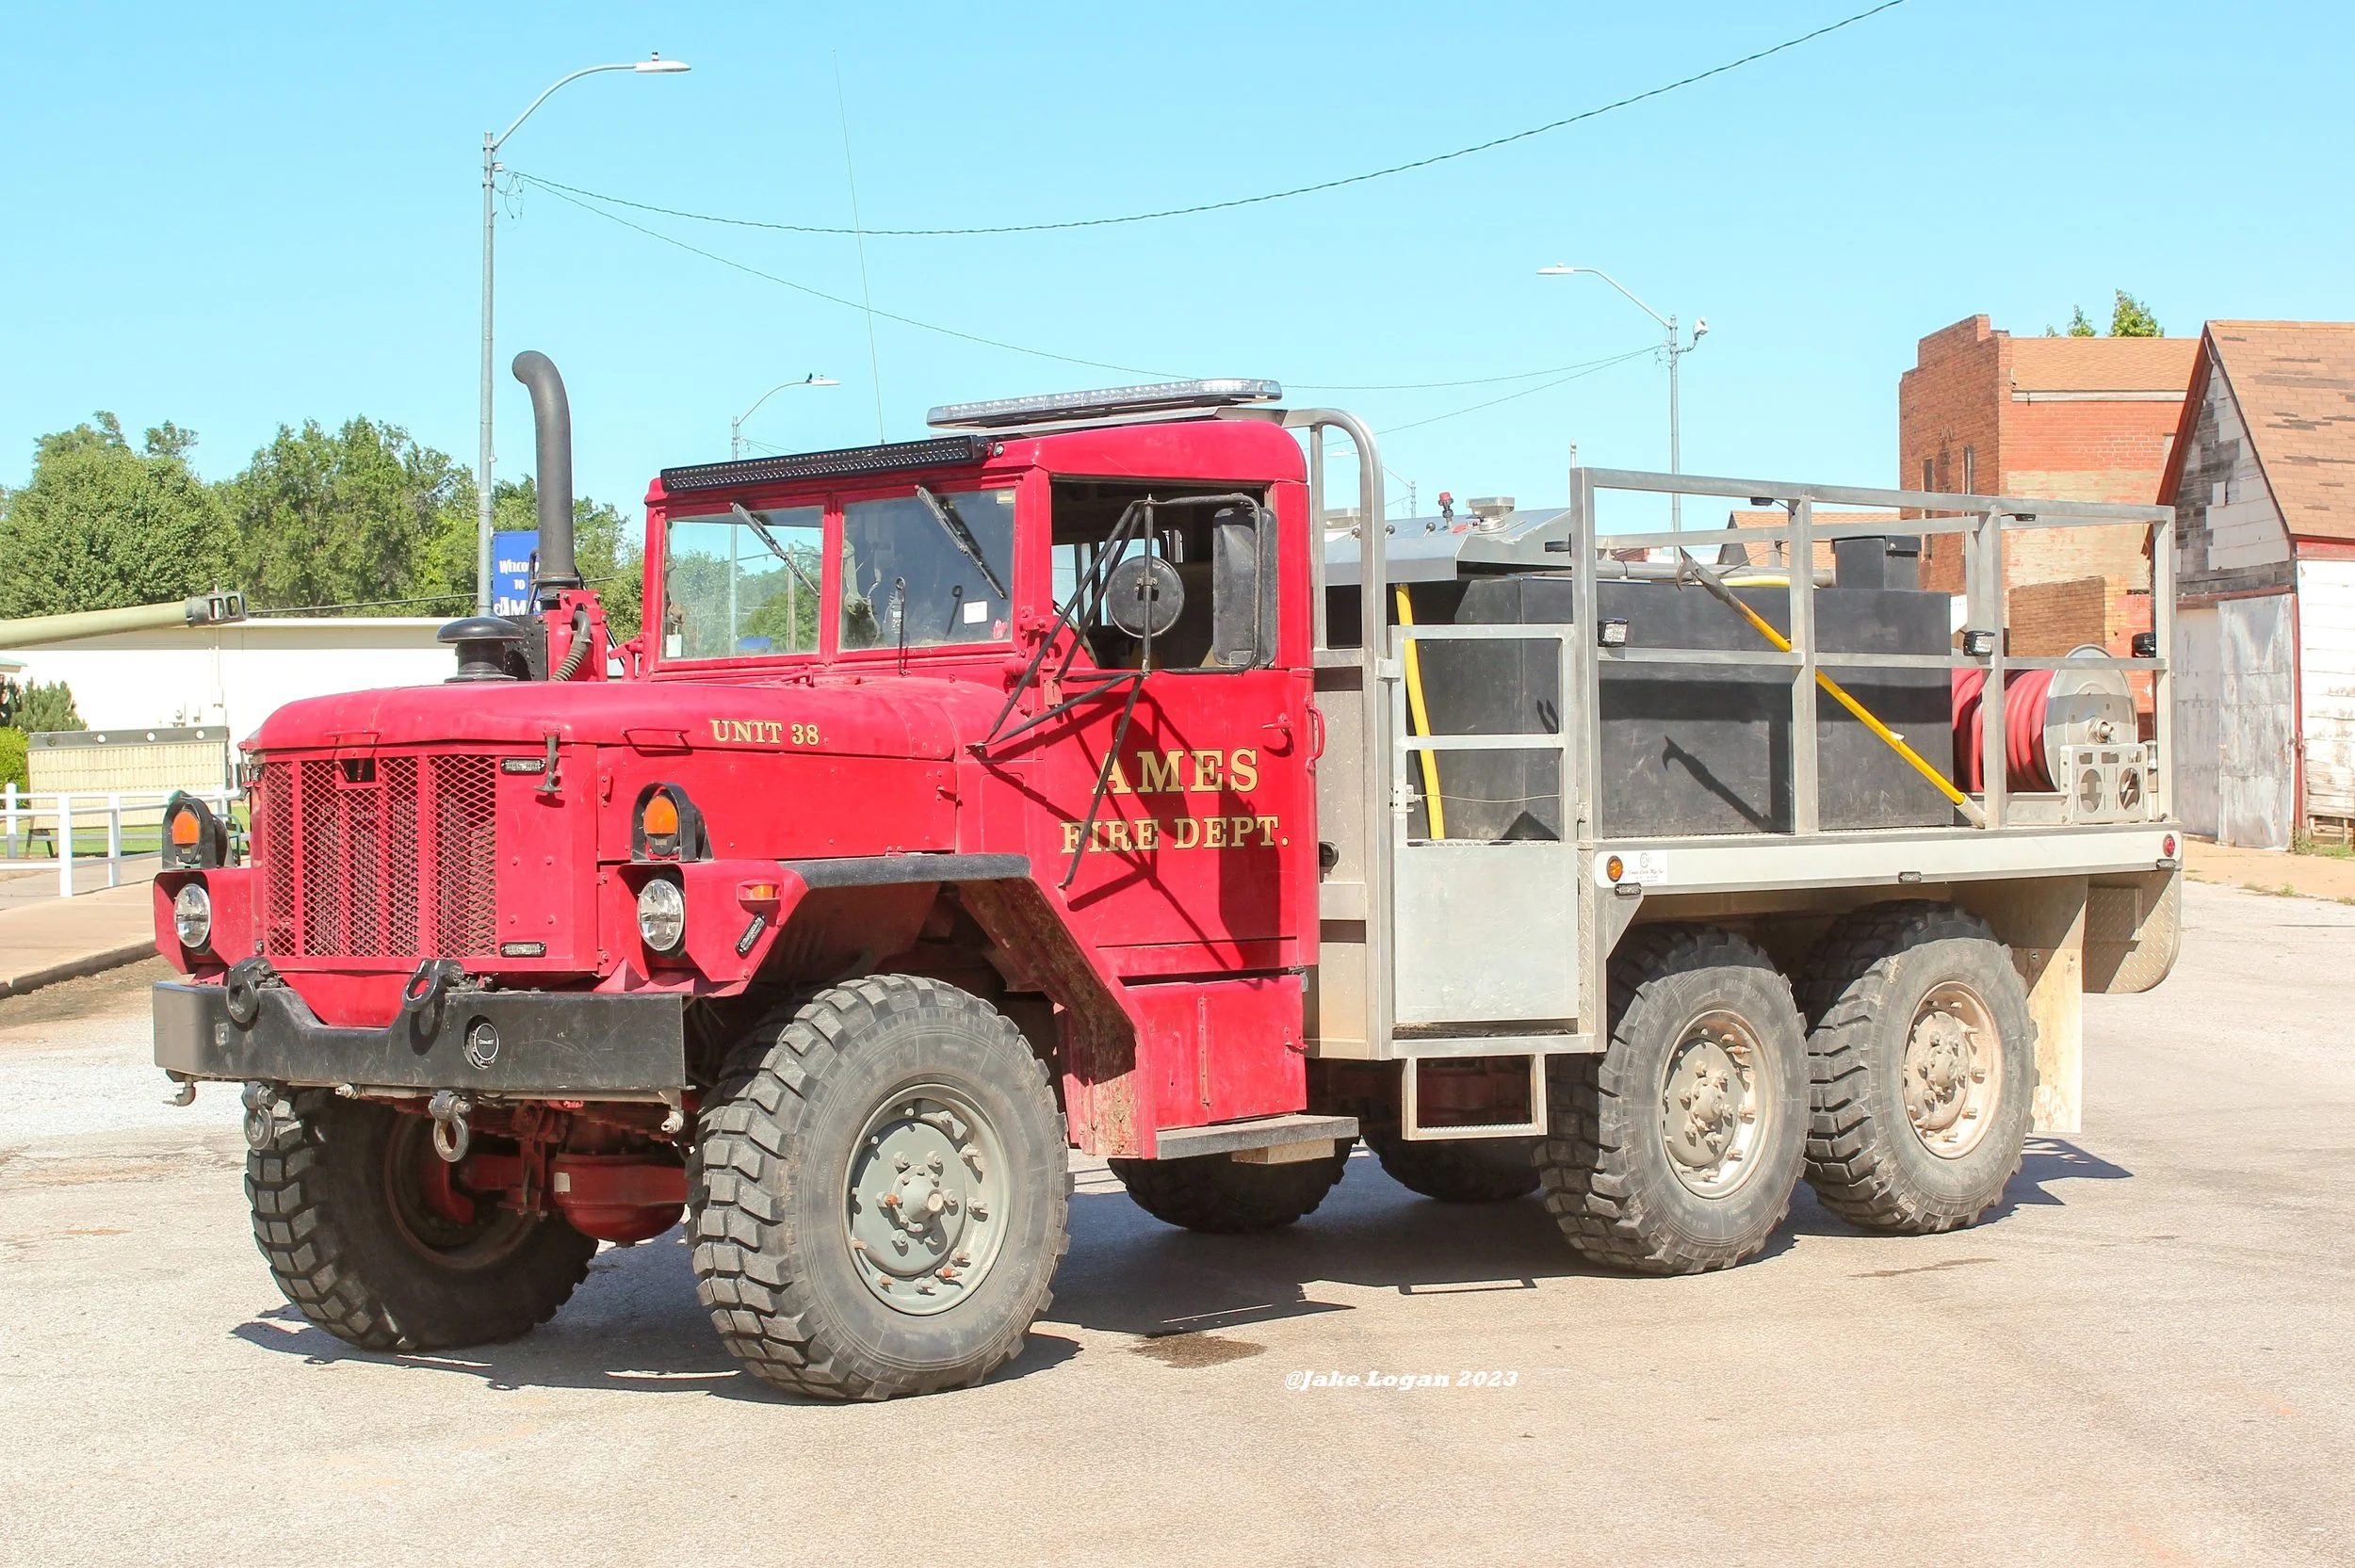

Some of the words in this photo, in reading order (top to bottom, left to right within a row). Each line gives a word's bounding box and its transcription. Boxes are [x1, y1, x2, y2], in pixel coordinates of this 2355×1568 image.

[513, 579, 526, 590] TO
[709, 719, 783, 743] UNIT
[790, 721, 820, 745] 38
[1091, 747, 1259, 796] AMES
[1059, 816, 1161, 854] FIRE
[1172, 815, 1291, 850] DEPT.
